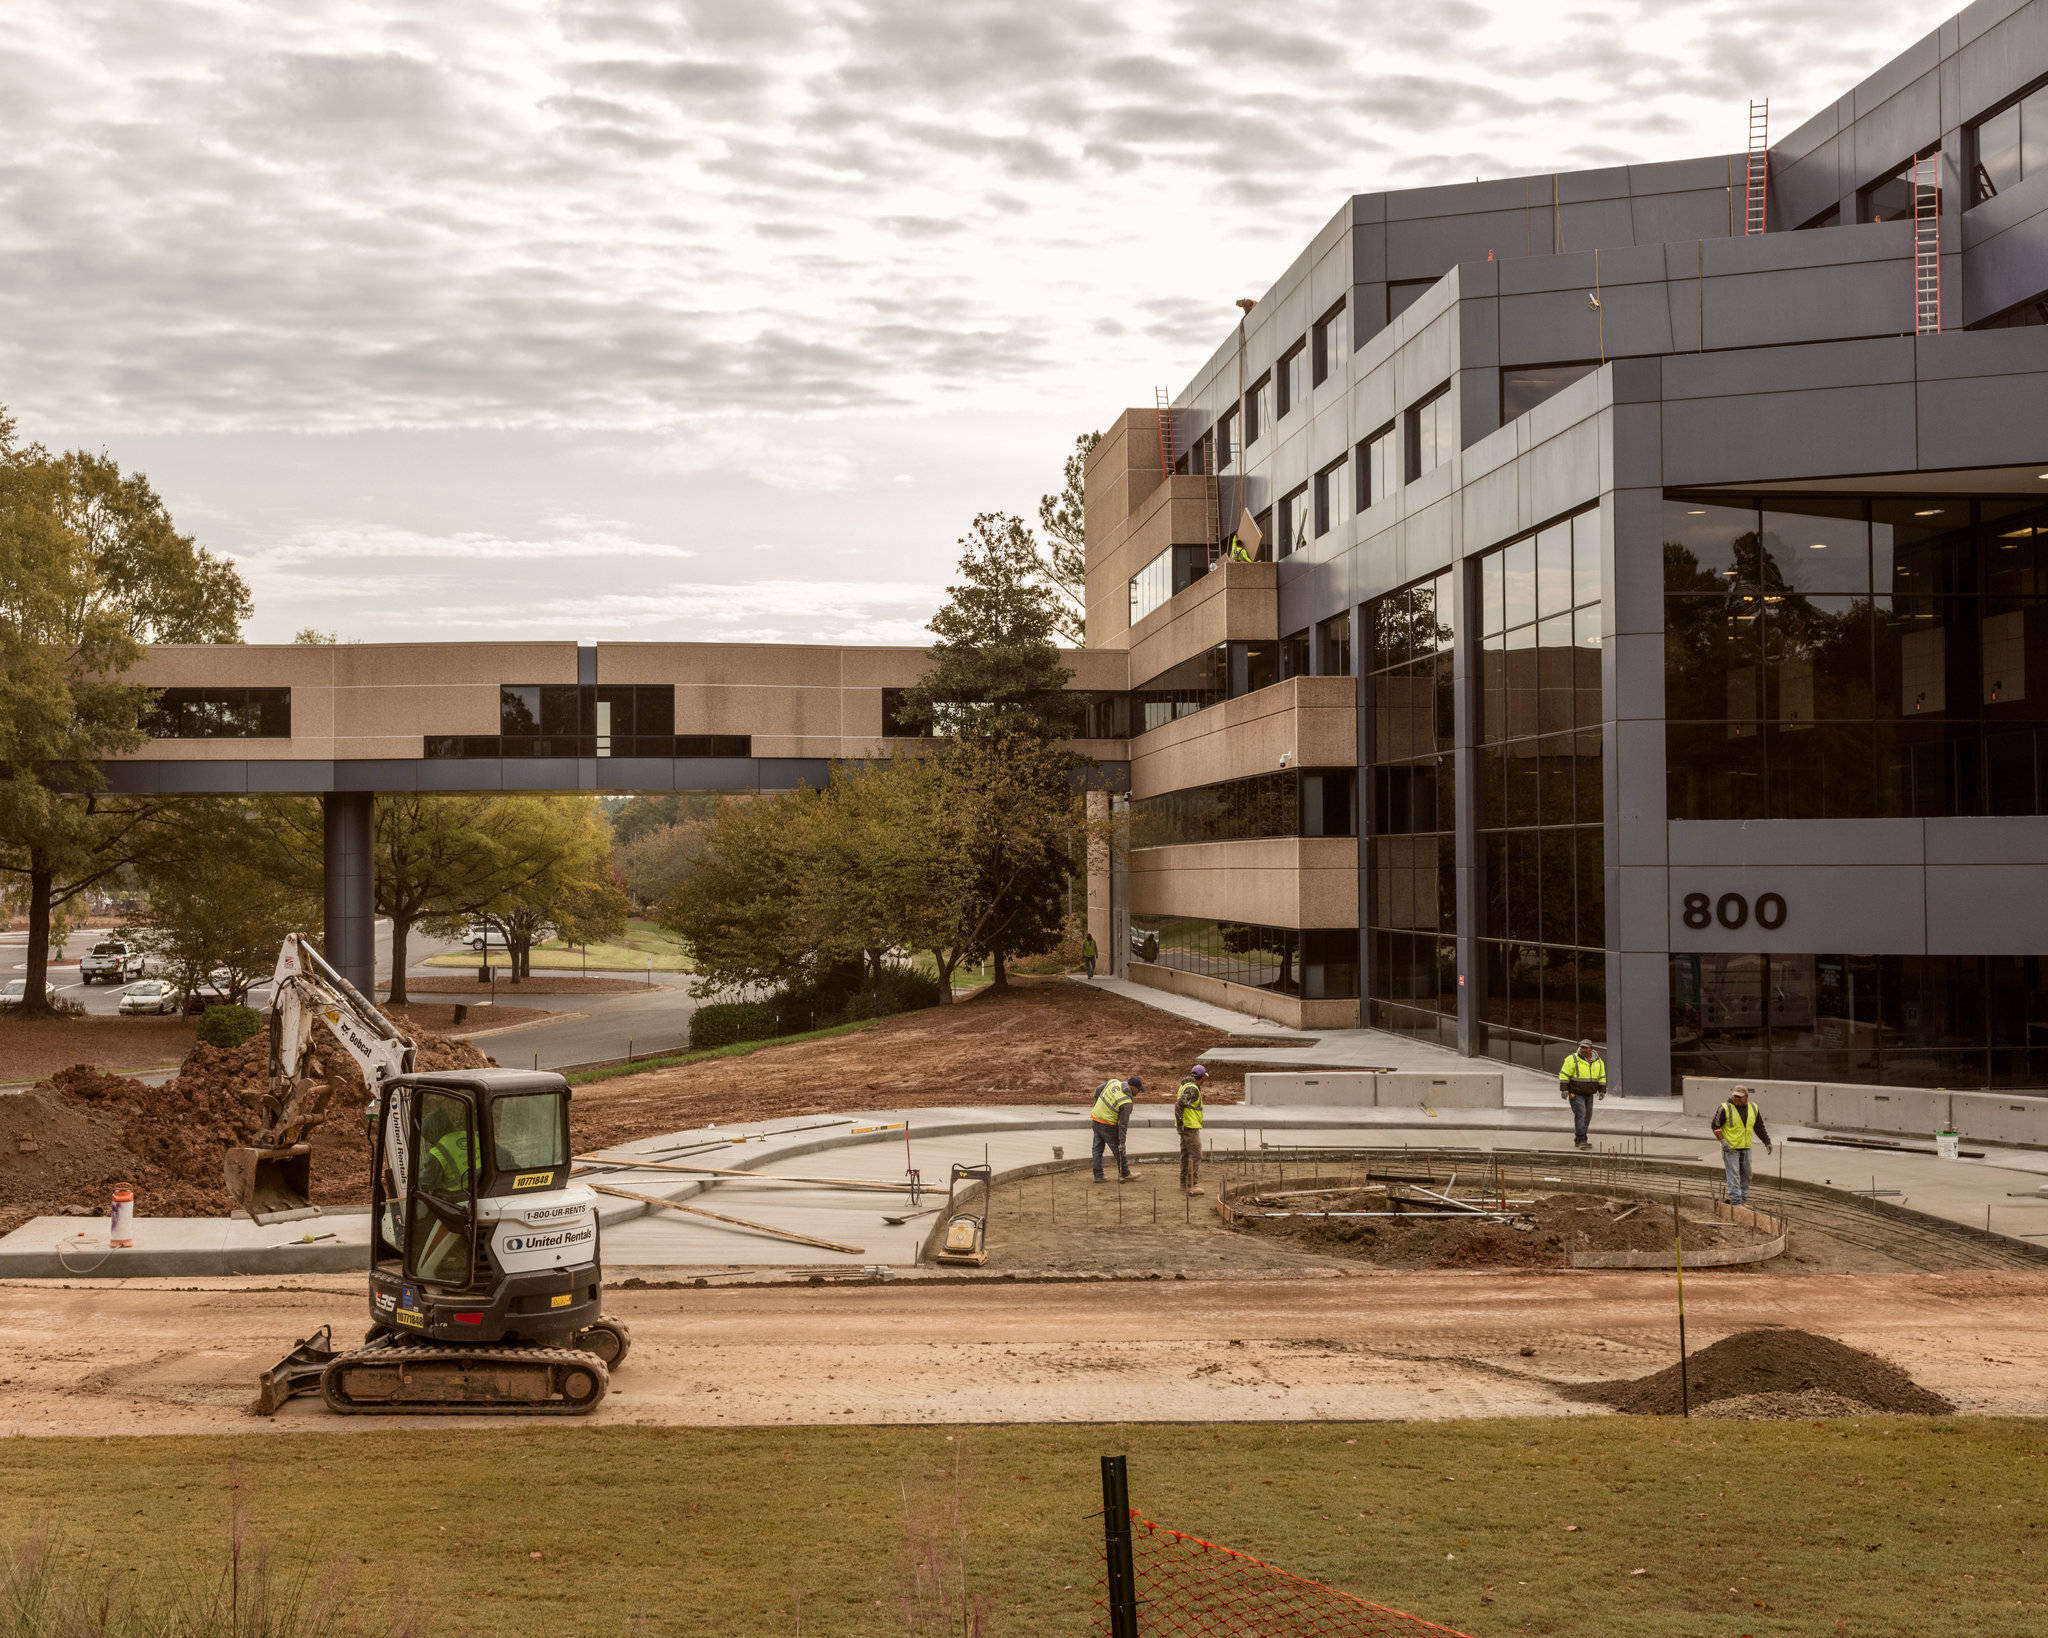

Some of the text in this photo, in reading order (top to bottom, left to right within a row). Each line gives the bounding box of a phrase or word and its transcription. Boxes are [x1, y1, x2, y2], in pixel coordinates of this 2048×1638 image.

[1683, 892, 1787, 930] 800
[350, 1032, 372, 1058] Bobcat
[392, 1112, 408, 1184] United Rentals
[527, 1205, 586, 1219] 1-800-UR-RENTS
[526, 1228, 592, 1248] United Rentals
